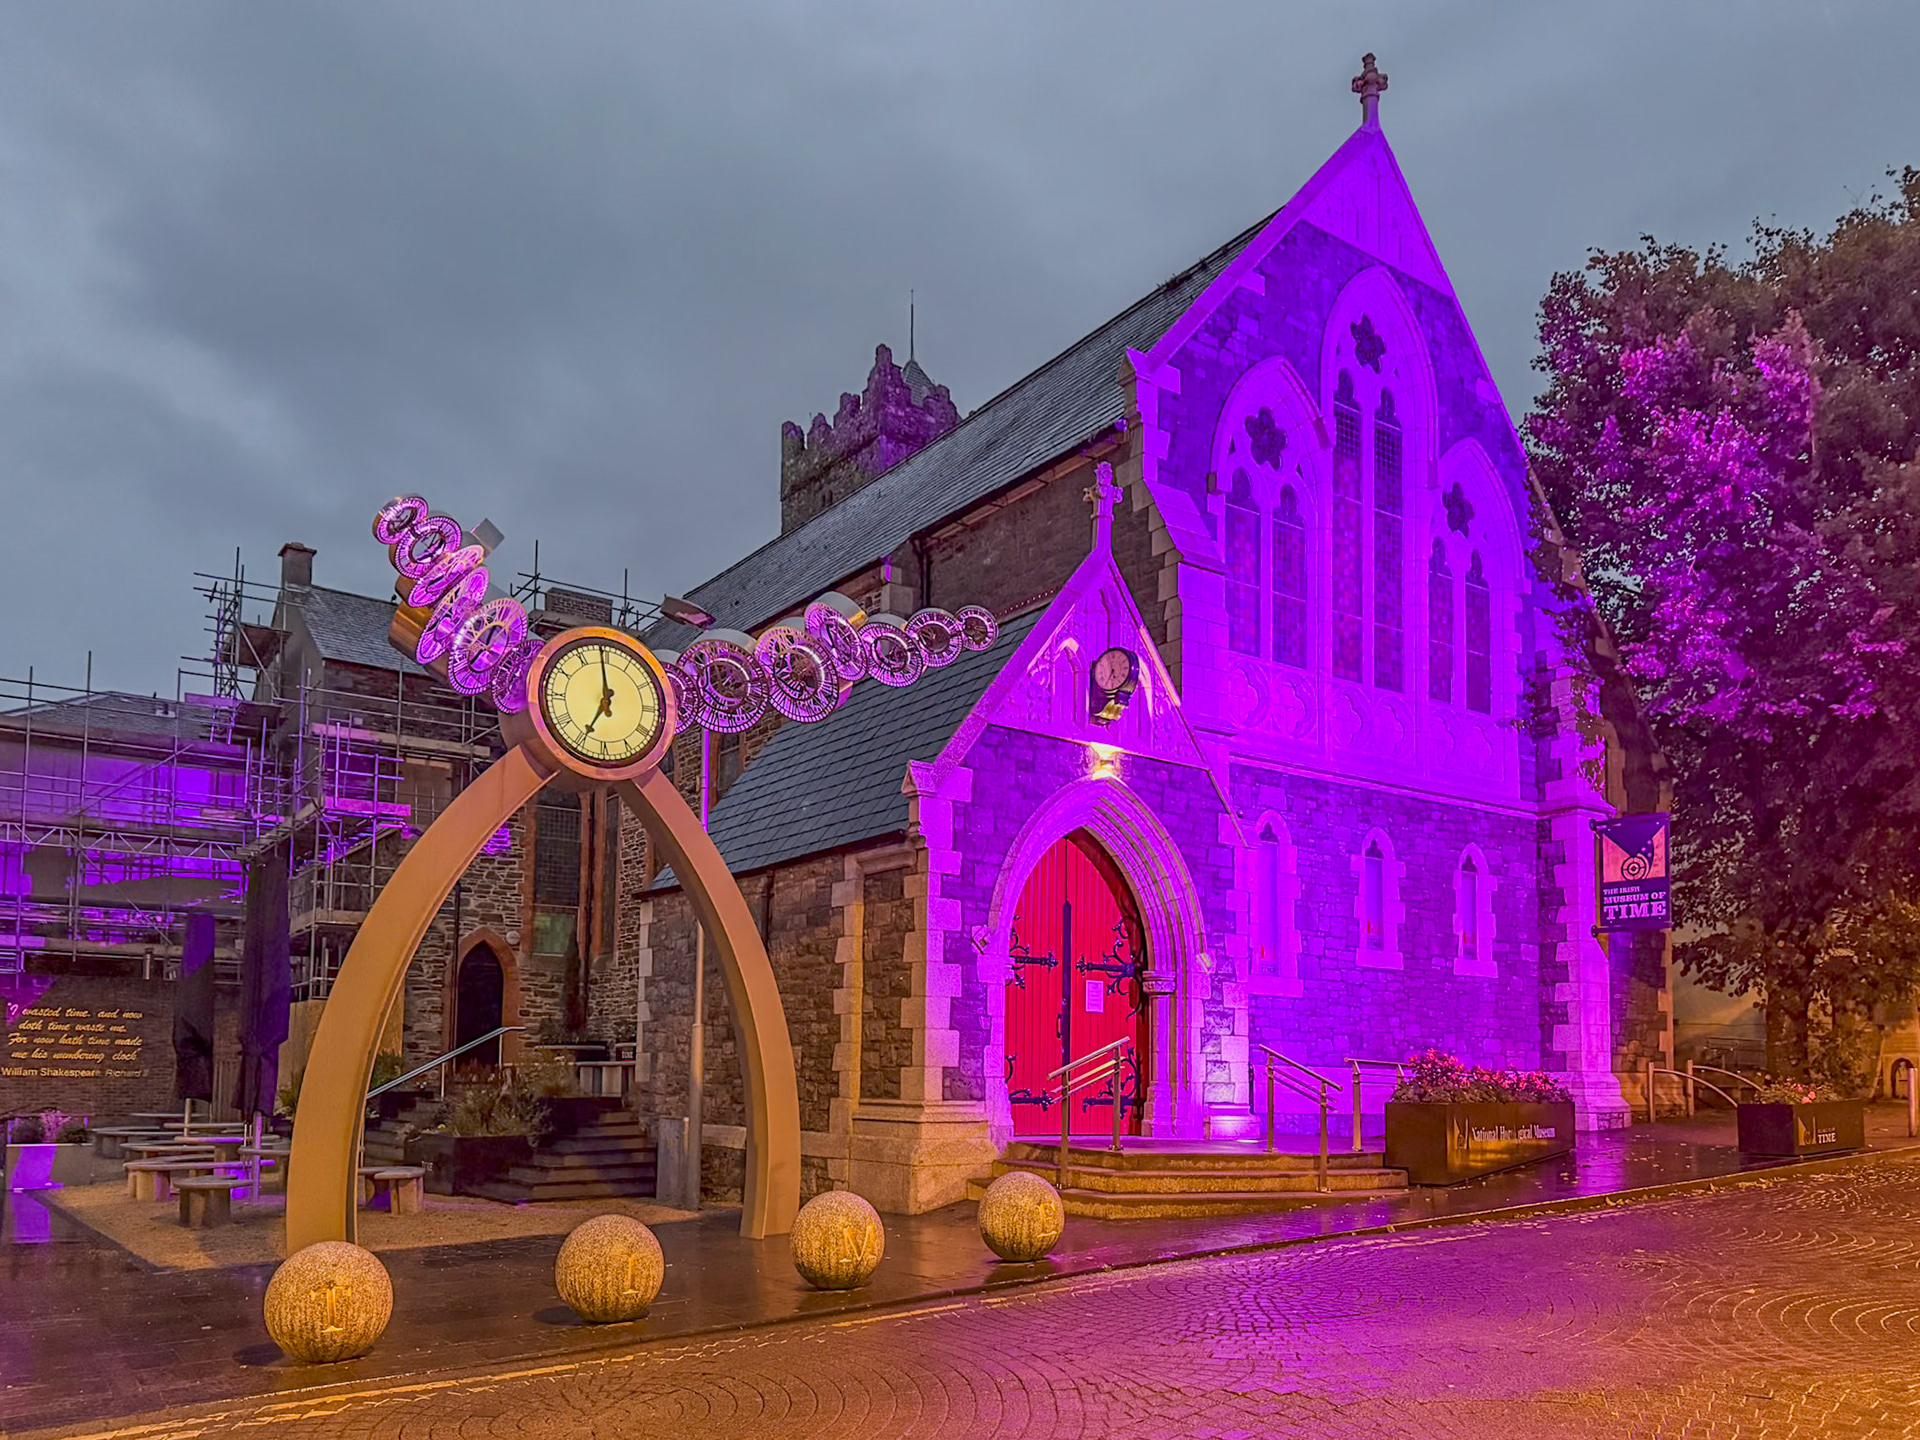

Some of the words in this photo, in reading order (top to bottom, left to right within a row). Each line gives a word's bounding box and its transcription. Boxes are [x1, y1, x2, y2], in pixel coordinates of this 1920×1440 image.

[1619, 886, 1640, 894] IRISH
[1603, 893, 1649, 904] MUSEUM
[1651, 891, 1666, 900] OF
[1603, 900, 1666, 920] TIME
[22, 1007, 61, 1017] wasted
[97, 1009, 119, 1019] and
[122, 1011, 143, 1019] now
[19, 1020, 43, 1031] doth
[48, 1021, 70, 1031] time
[75, 1023, 105, 1032] waste
[8, 1032, 27, 1045] For
[33, 1037, 54, 1045] now
[59, 1034, 84, 1045] hath
[88, 1035, 110, 1045] time
[115, 1036, 143, 1046] made
[11, 1051, 28, 1059] me
[31, 1047, 48, 1059] his
[53, 1049, 105, 1063] numbering
[1, 1066, 38, 1077] William
[40, 1067, 101, 1077] Shakespeare
[105, 1069, 142, 1078] Richard
[1472, 1125, 1498, 1142] National
[1817, 1132, 1836, 1144] TIME
